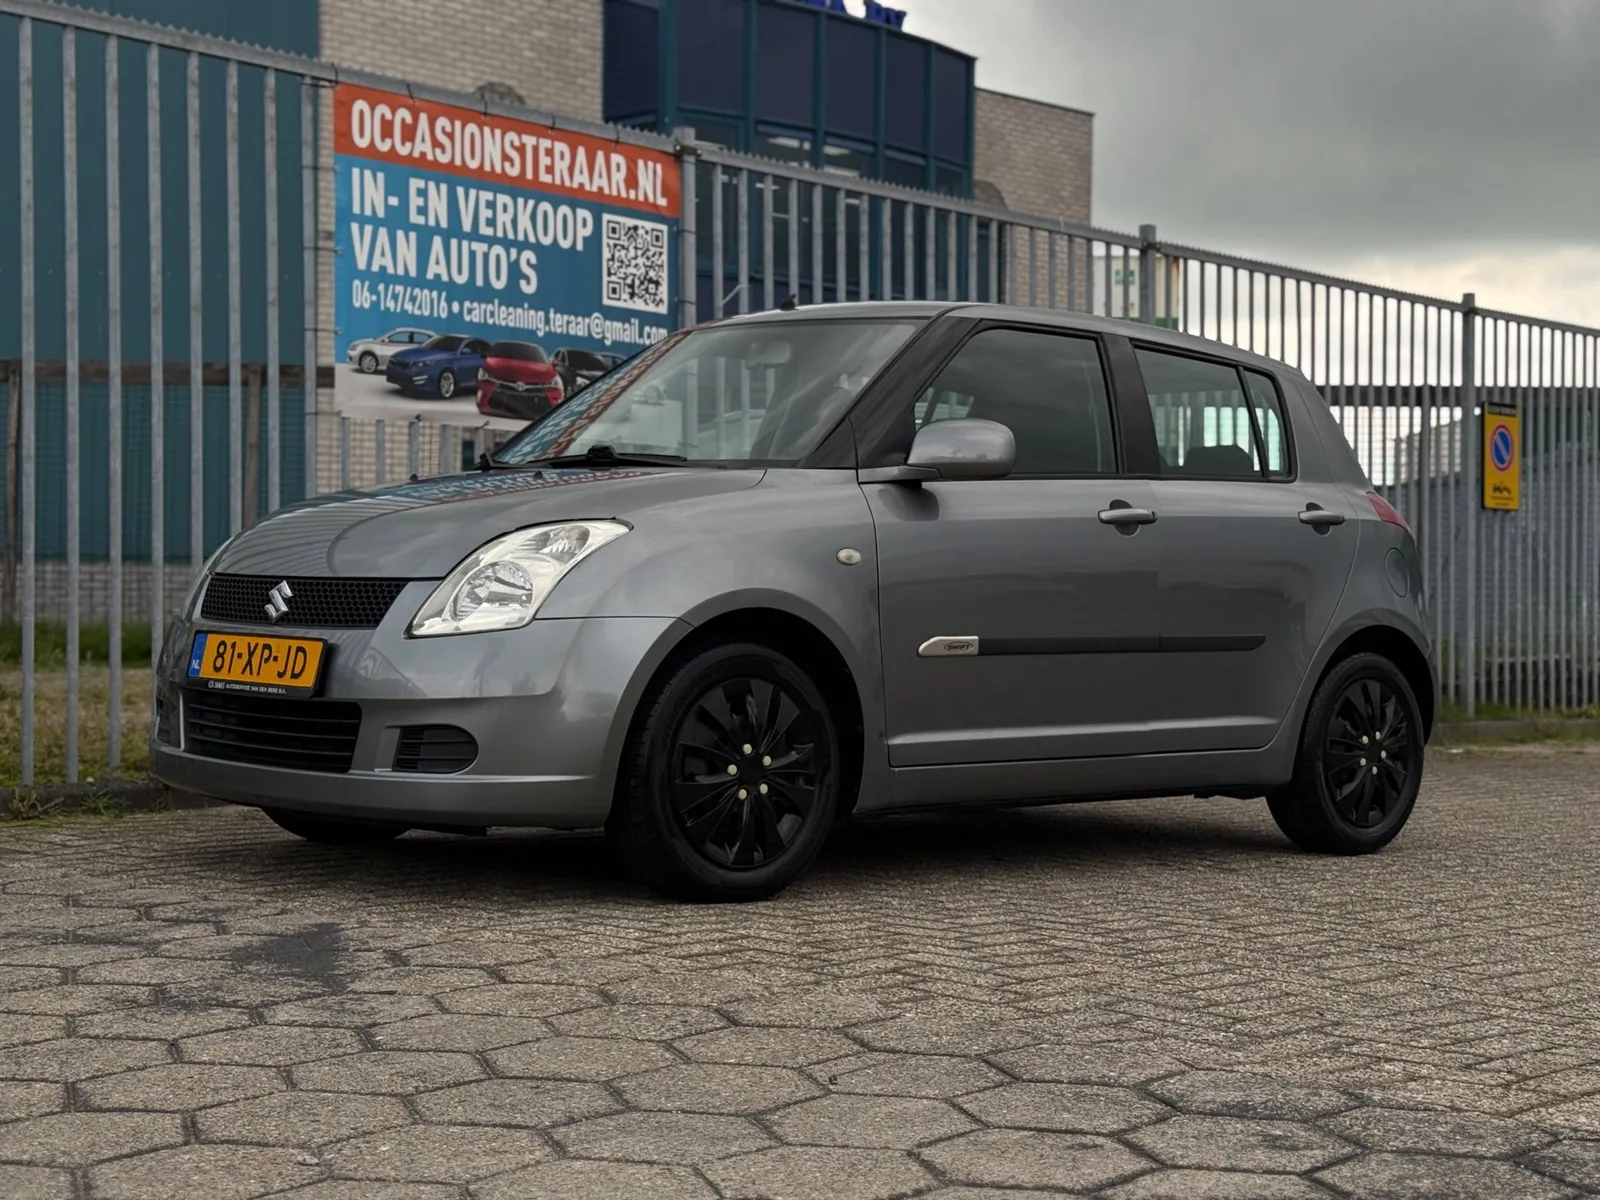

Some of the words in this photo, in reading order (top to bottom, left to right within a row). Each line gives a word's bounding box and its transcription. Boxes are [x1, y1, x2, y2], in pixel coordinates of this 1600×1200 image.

[351, 98, 668, 207] OCCASIONSTERAAR.NL
[351, 167, 399, 218] IN-
[409, 177, 448, 228] EN
[456, 186, 594, 251] VERKOOP
[351, 222, 418, 278] VAN
[426, 235, 538, 295] AUTO'S
[352, 279, 448, 318] 06-14742016
[463, 299, 668, 346] carcleaning.teraar@gmail.com
[191, 659, 200, 669] NL
[212, 640, 308, 680] 81-XP-JD
